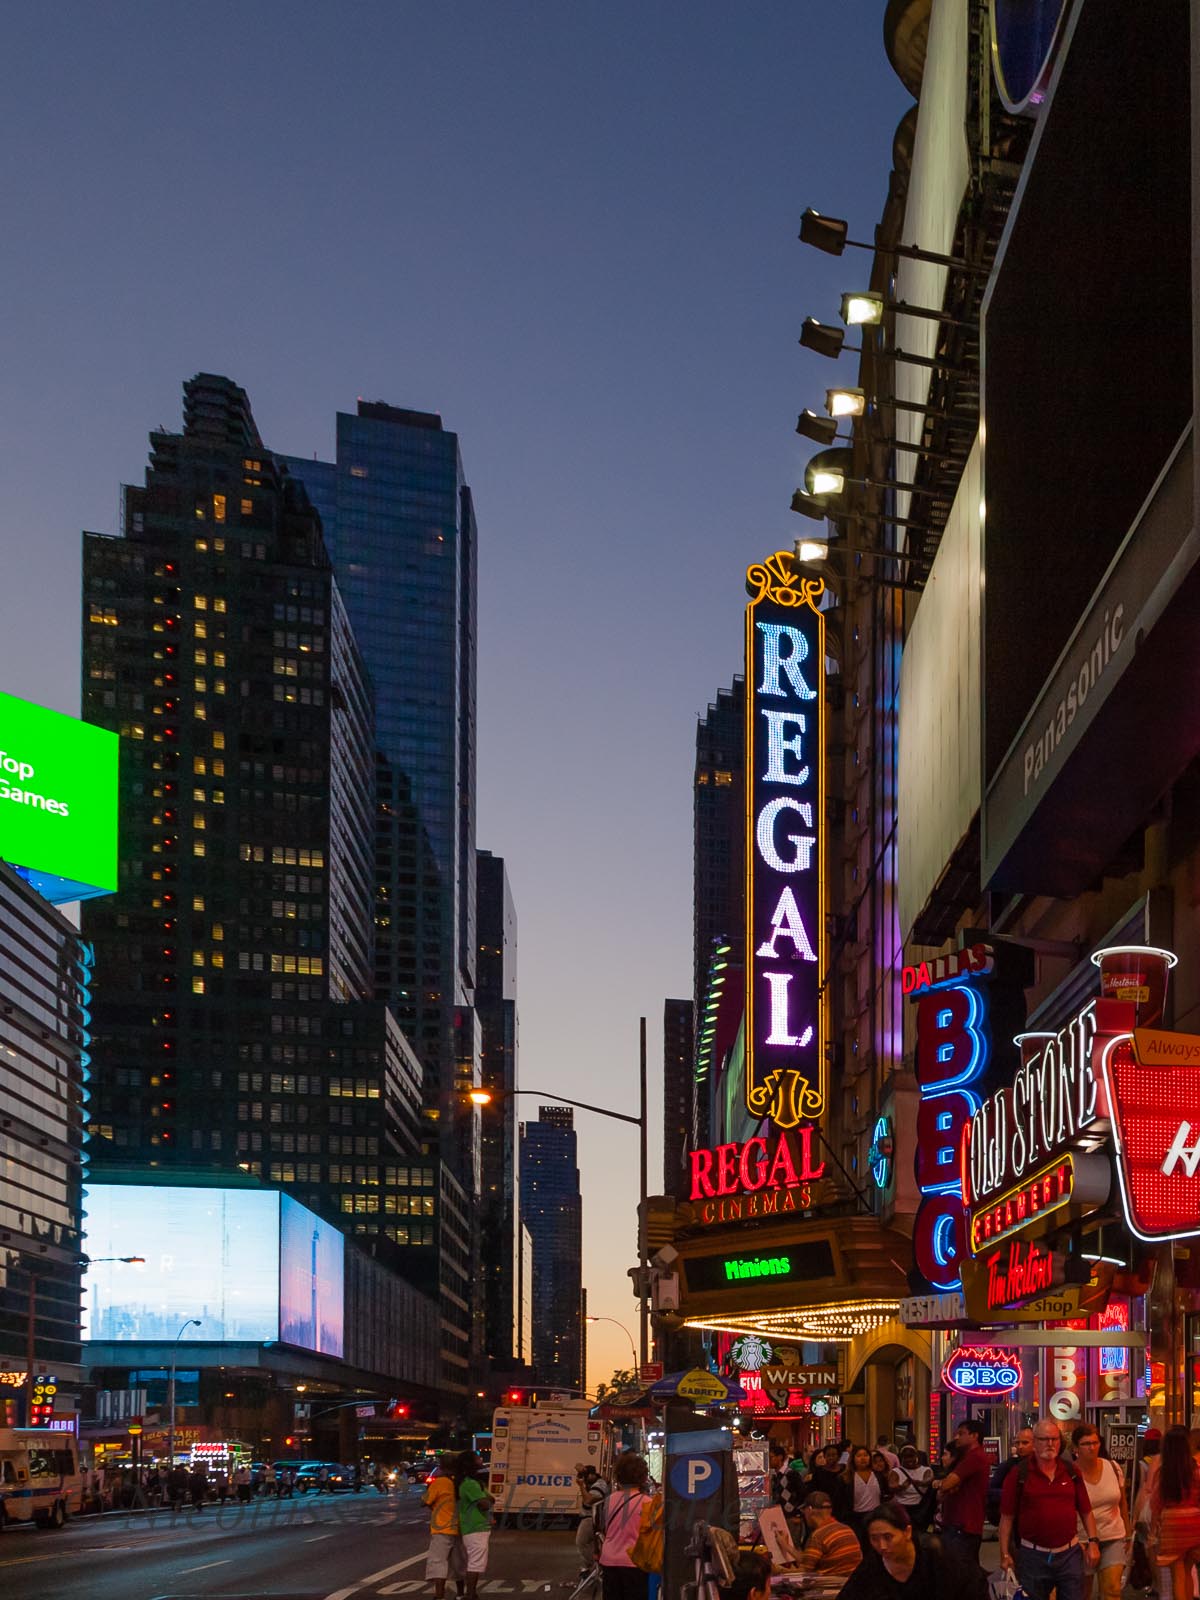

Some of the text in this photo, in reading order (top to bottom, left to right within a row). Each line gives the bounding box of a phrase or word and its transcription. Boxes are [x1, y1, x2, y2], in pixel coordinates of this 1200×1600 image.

[1024, 604, 1124, 796] Panasonic
[0, 751, 35, 780] Top
[0, 780, 70, 818] Games
[756, 621, 818, 1047] REGAL
[902, 945, 988, 994] DALLAS
[1146, 1039, 1200, 1061] Always
[1012, 1000, 1096, 1176] STONE
[689, 1125, 825, 1201] REGAL
[703, 1186, 813, 1224] CINEMAS
[725, 1256, 791, 1280] Minions
[1034, 1299, 1073, 1316] shop
[767, 1370, 835, 1385] WESTIN
[955, 1368, 1018, 1386] BBQ
[681, 1387, 724, 1397] SABRETT
[1111, 1435, 1135, 1446] BBQ
[517, 1474, 572, 1487] POLICE
[688, 1460, 711, 1493] P
[377, 1580, 552, 1594] OLY
